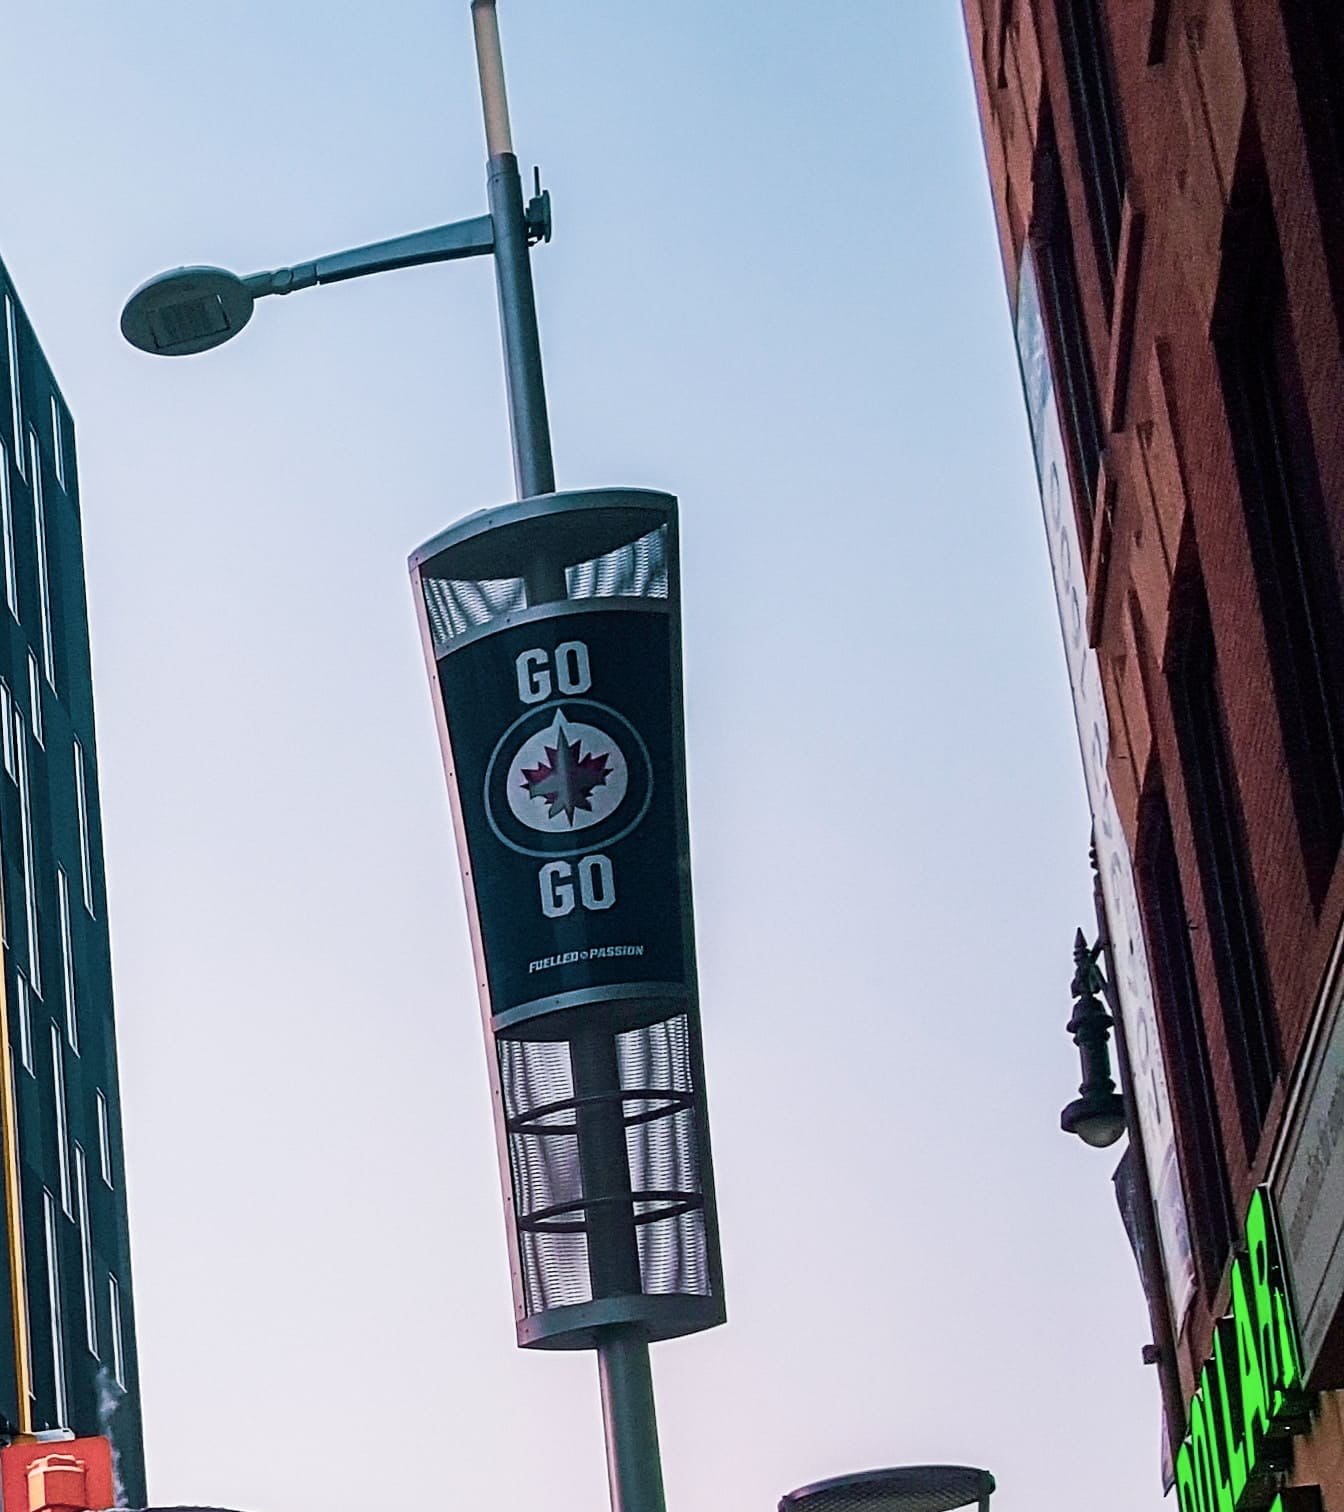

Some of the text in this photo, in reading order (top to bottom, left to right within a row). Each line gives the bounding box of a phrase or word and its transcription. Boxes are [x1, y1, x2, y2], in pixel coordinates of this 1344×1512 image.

[516, 641, 592, 705] GO
[538, 854, 616, 918] GO
[529, 945, 644, 973] FUELLED PASSION
